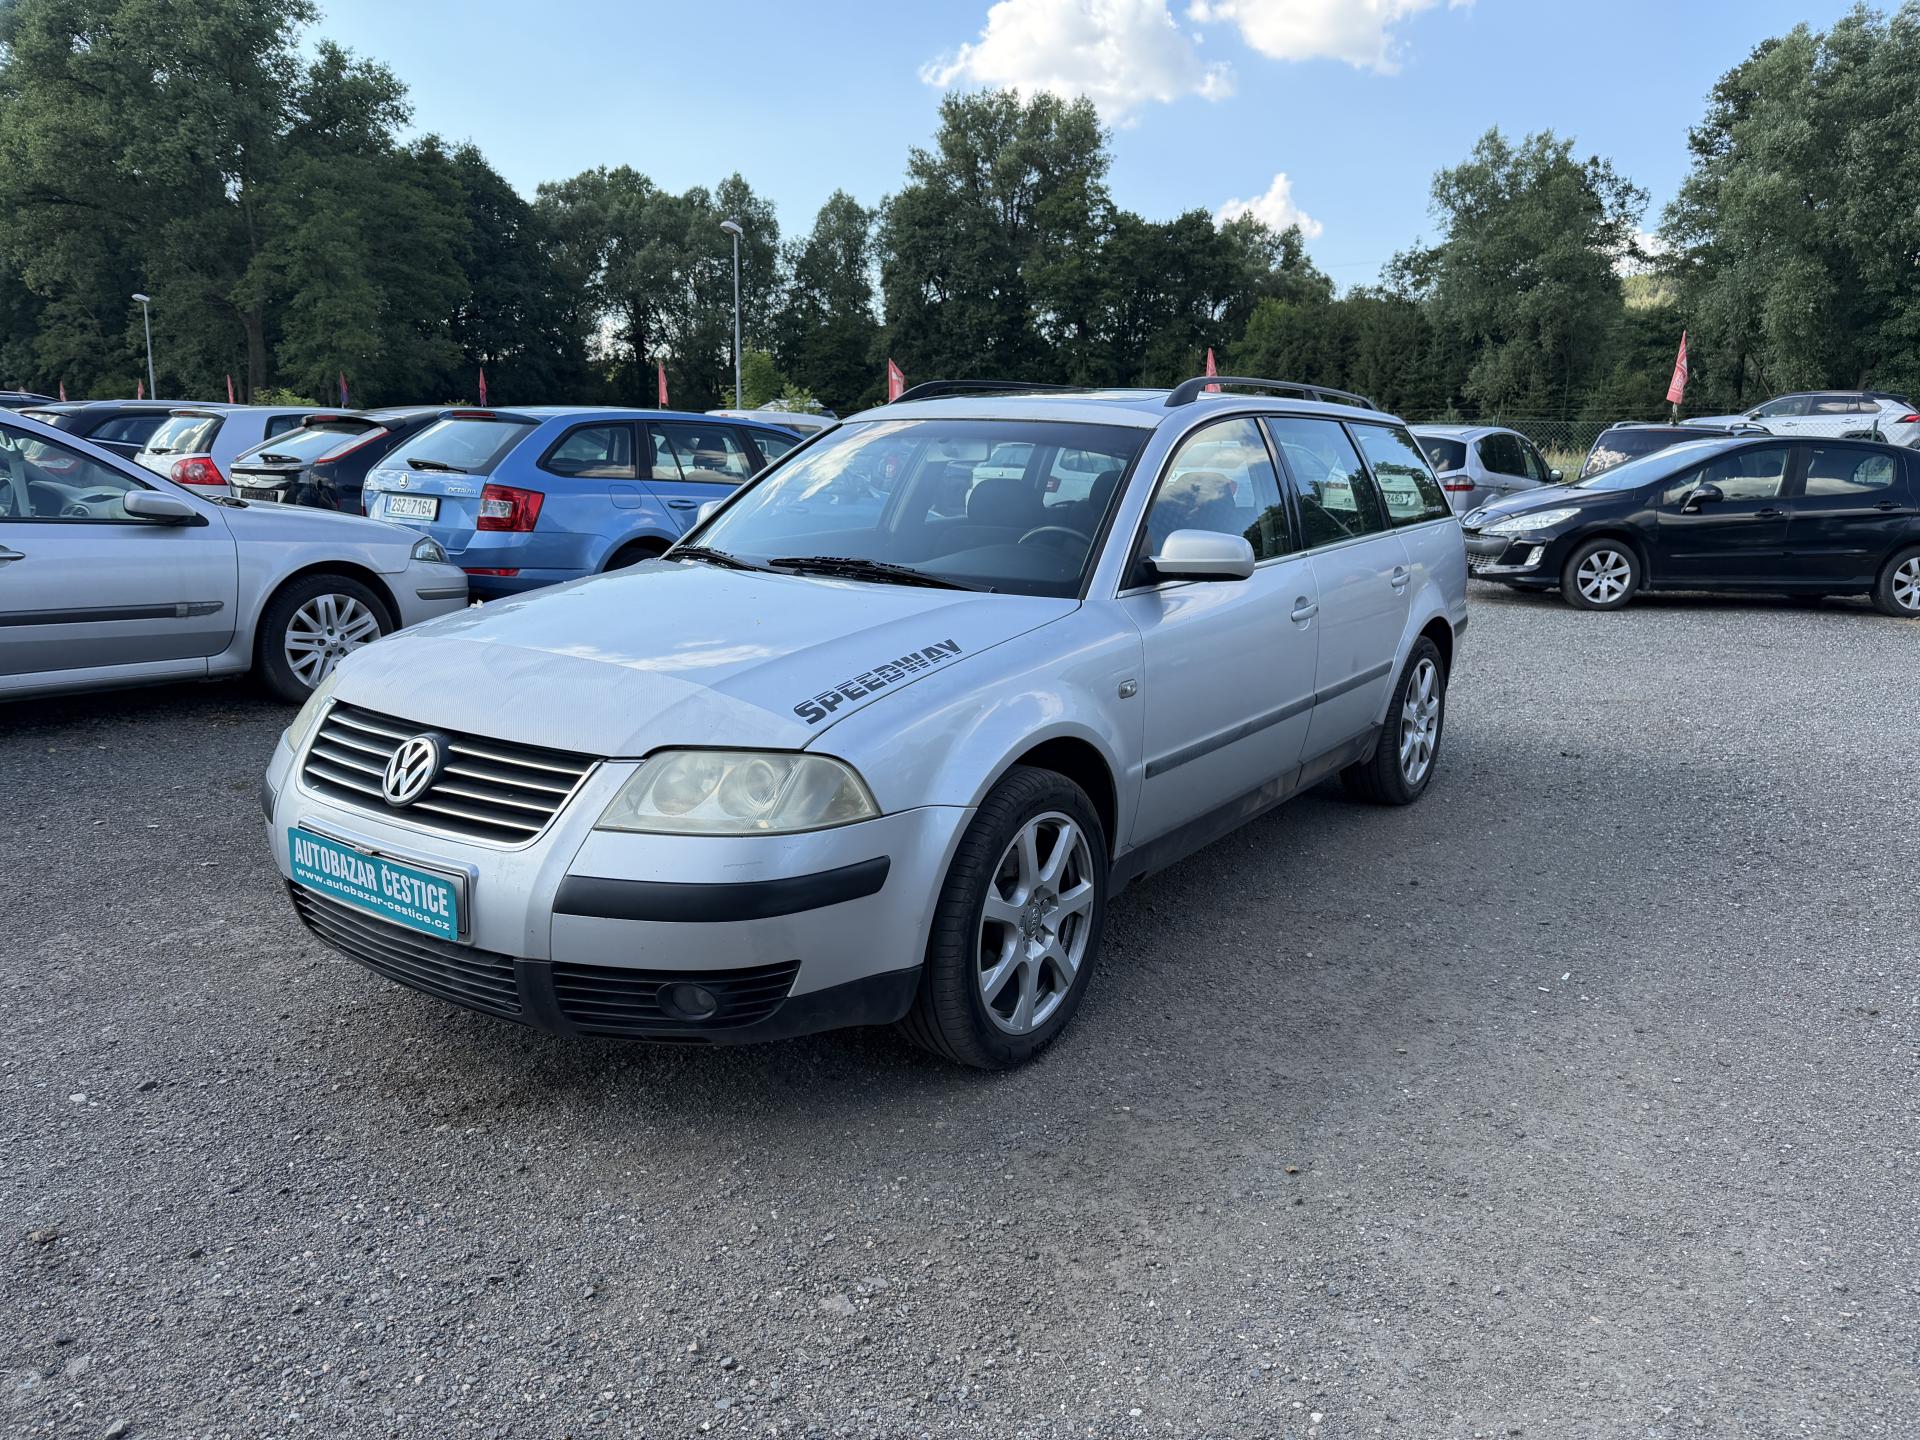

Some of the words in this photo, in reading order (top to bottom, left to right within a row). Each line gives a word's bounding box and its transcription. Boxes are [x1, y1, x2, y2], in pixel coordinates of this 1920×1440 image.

[410, 499, 432, 515] 7164
[793, 638, 962, 725] SPEEDWAY
[295, 837, 378, 892] AUTOBAZAR
[381, 864, 449, 917] ČESTICE
[296, 867, 450, 931] www.autobazar-cestice.cz
